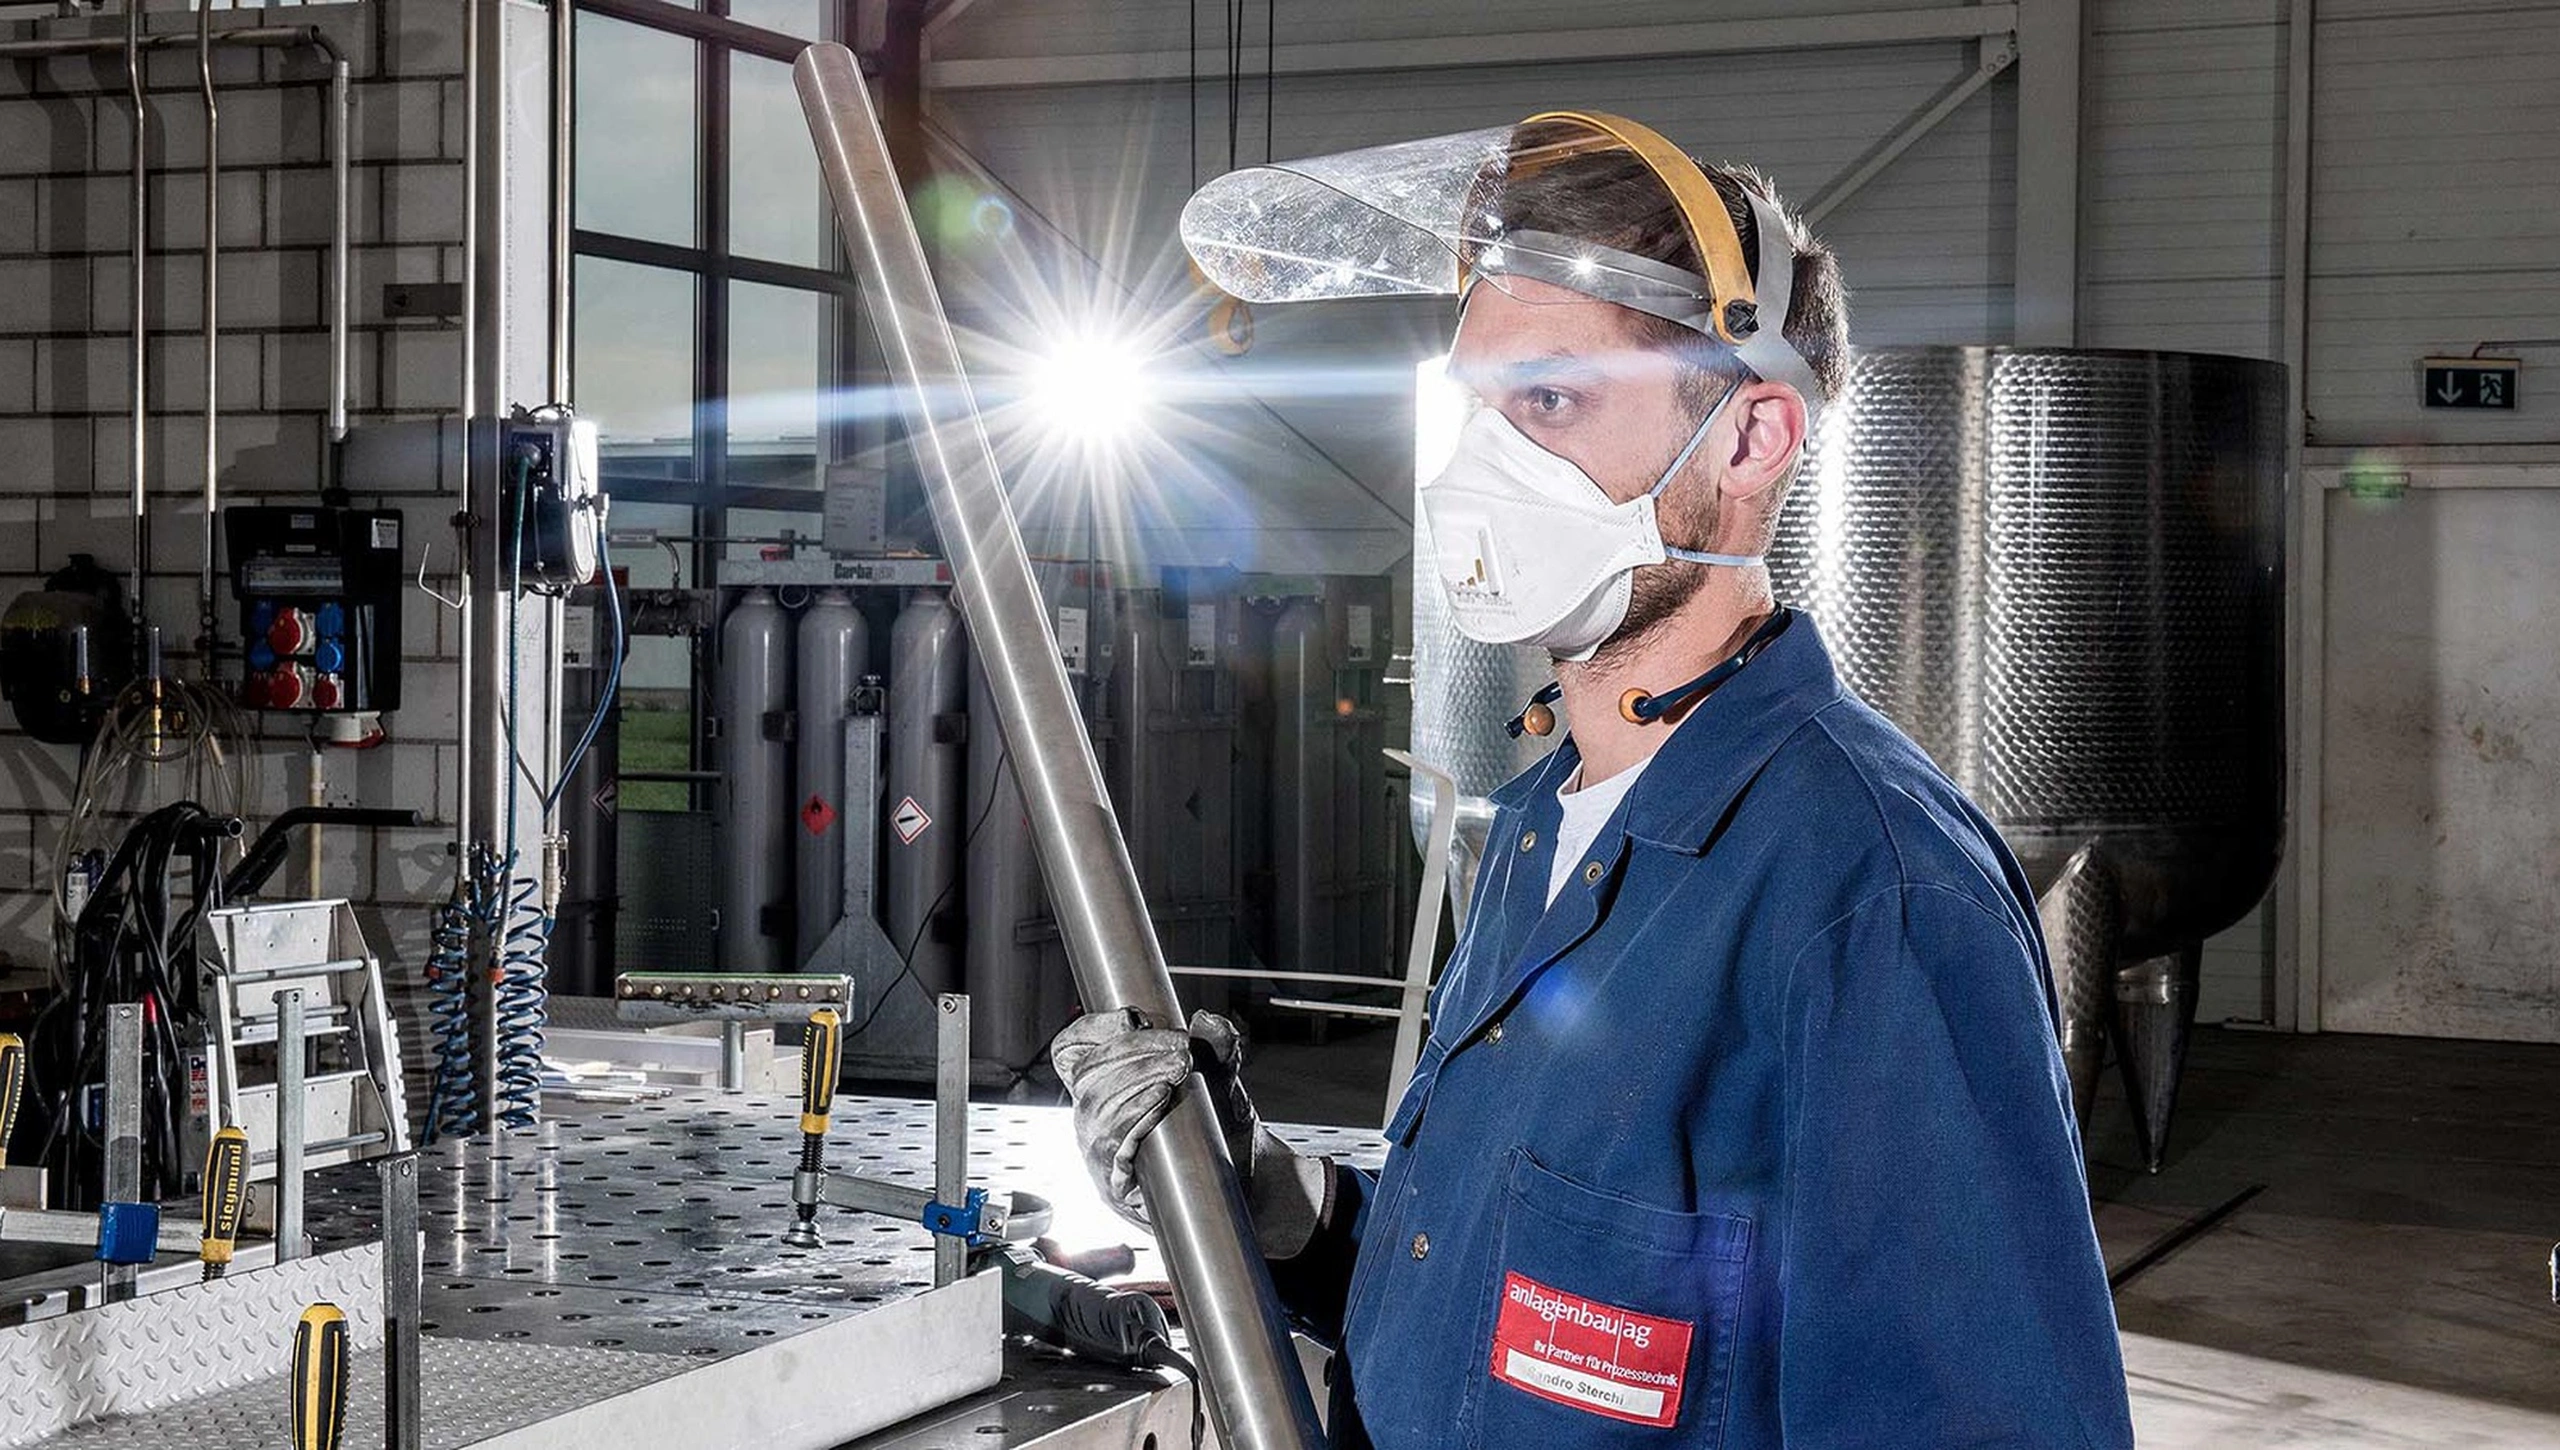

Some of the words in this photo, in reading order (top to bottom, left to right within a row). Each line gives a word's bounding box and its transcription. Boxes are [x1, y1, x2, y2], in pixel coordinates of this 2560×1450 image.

[220, 1143, 242, 1231] siegmund
[1509, 1283, 1619, 1335] anlagenbau
[1622, 1320, 1653, 1348] ag
[1548, 1344, 1584, 1366] Partner
[1586, 1354, 1601, 1371] für
[1602, 1361, 1678, 1387] Prozesstechnik
[1577, 1381, 1625, 1406] Sterchi
